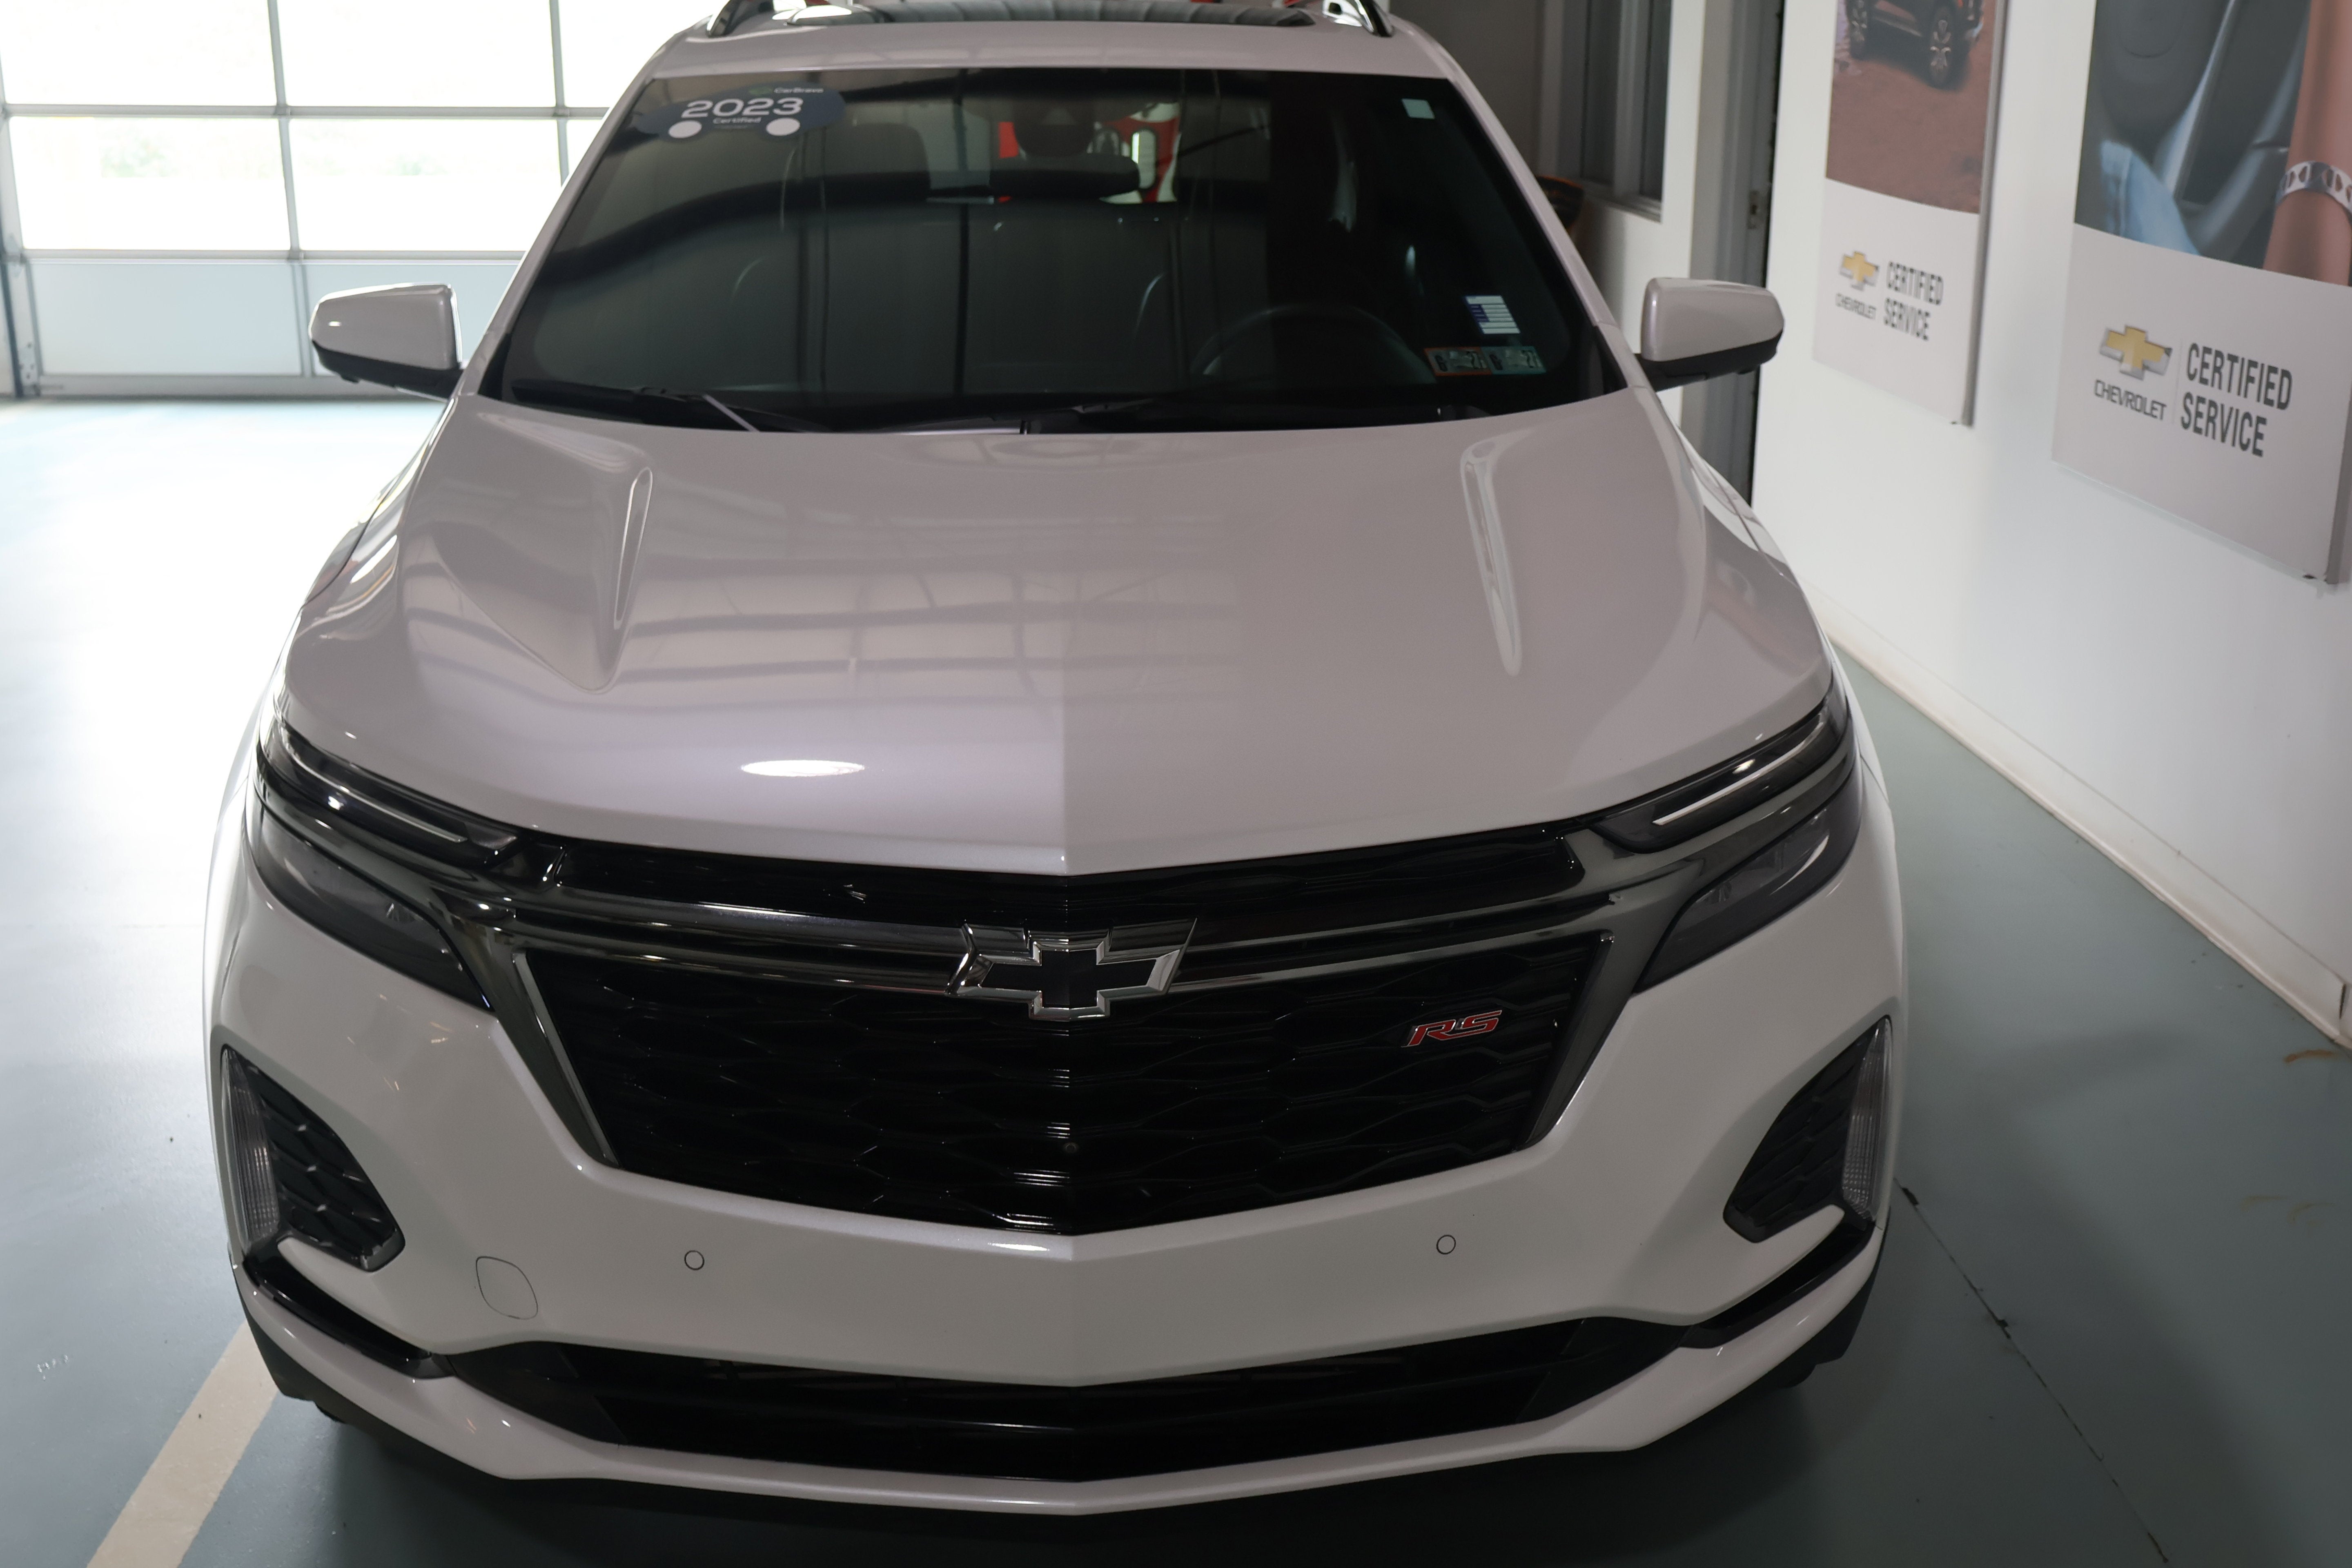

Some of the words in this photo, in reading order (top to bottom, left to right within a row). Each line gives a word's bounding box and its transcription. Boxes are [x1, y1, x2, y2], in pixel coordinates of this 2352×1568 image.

[681, 97, 803, 118] 2023
[1886, 261, 1944, 305] CERTIFIED
[1883, 297, 1931, 341] SERVICE
[2186, 343, 2293, 411] CERTIFIED
[2094, 379, 2167, 421] CHEVROLET
[2180, 391, 2267, 457] SERVICE
[1401, 1010, 1502, 1047] RS
